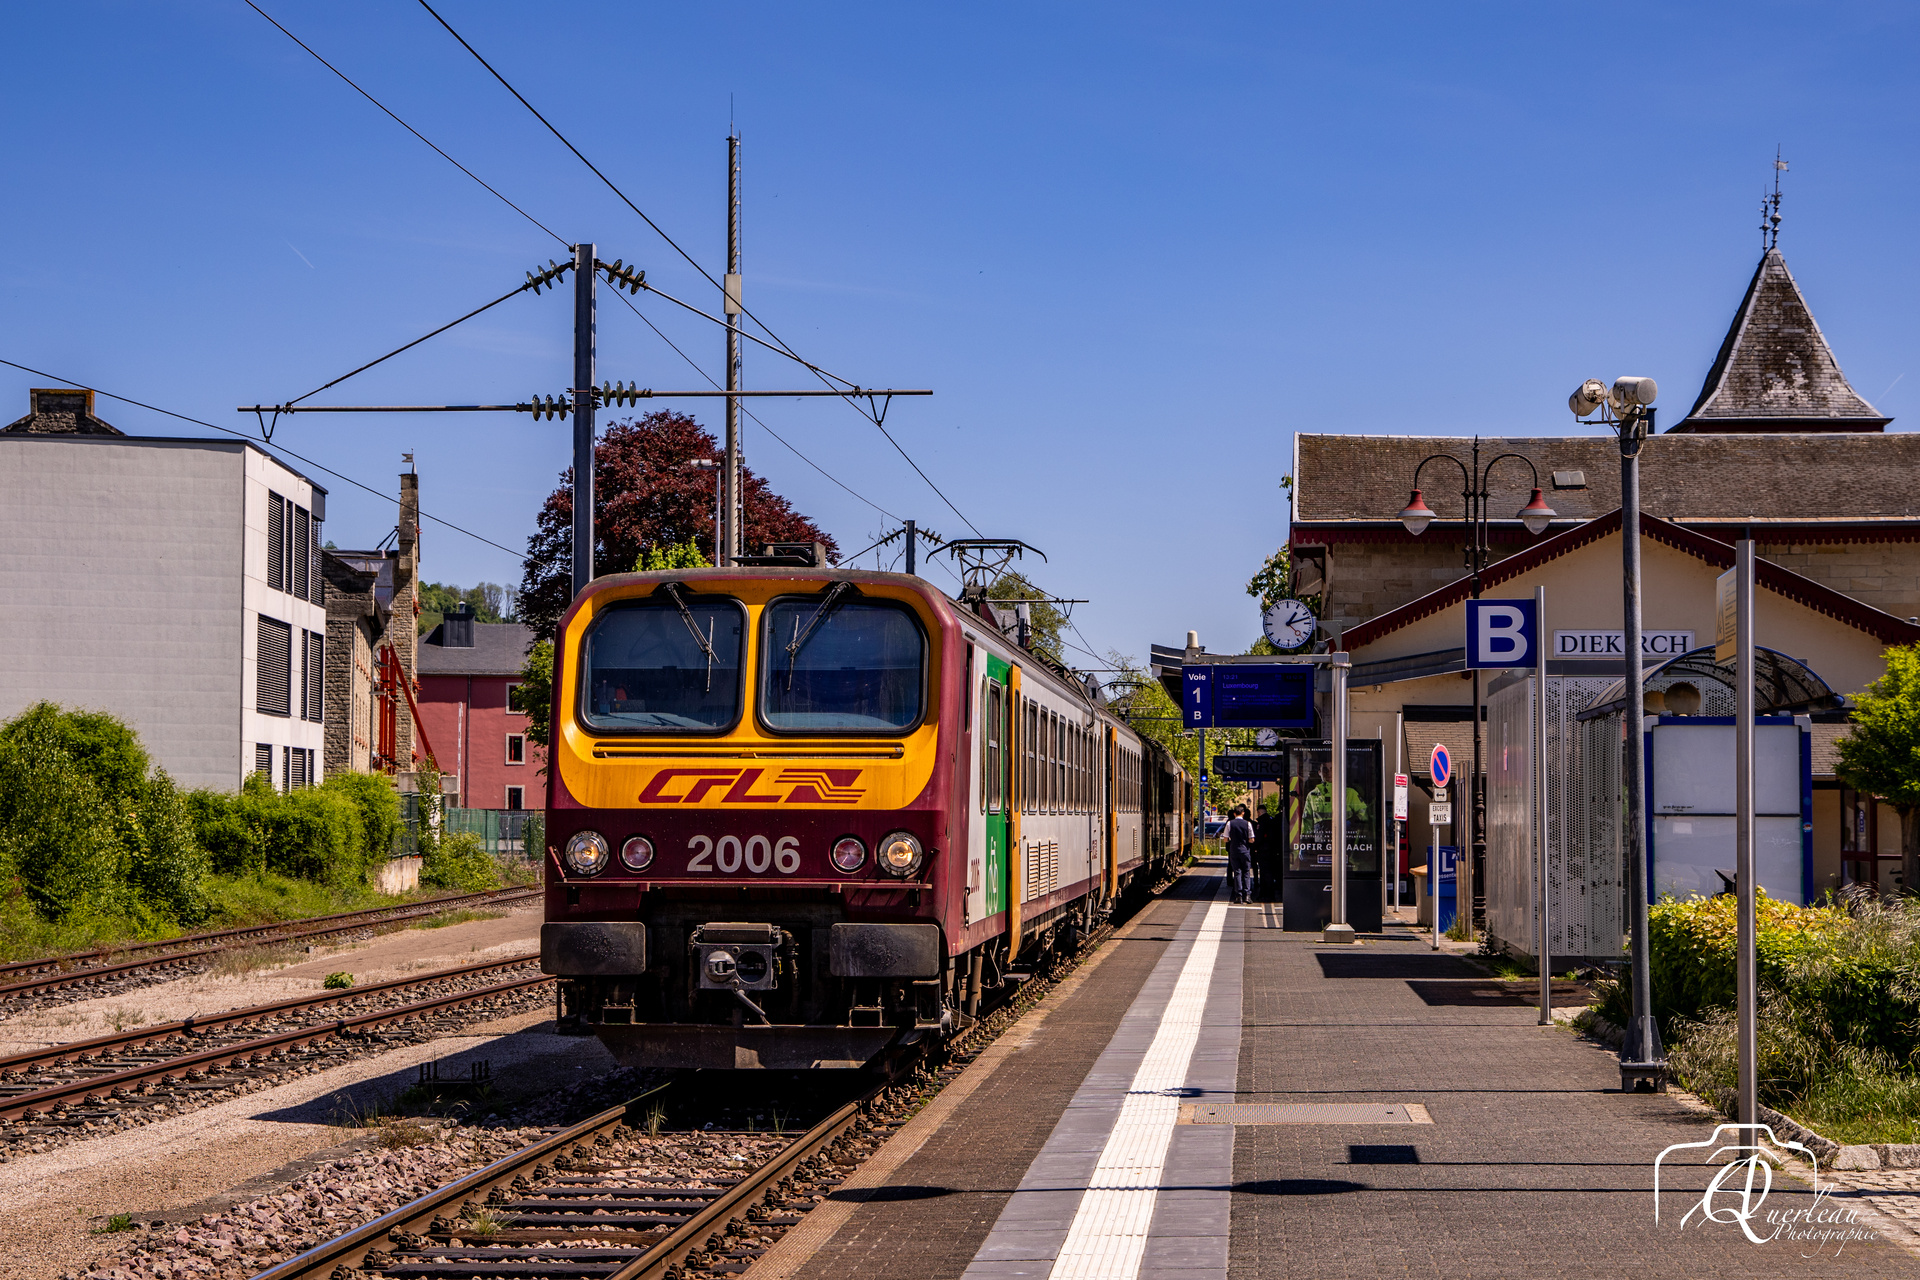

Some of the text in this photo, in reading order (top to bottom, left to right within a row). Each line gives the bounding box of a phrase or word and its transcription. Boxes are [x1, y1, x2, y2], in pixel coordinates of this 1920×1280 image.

[1478, 605, 1528, 662] B
[1560, 635, 1689, 654] DIEKRCH
[1188, 673, 1206, 681] Voie
[1222, 682, 1259, 690] Luxembourg
[1192, 687, 1201, 704] 1
[1193, 710, 1202, 720] B
[1221, 760, 1284, 773] DIEKIRC
[638, 768, 783, 803] CFL
[1433, 814, 1447, 822] TAXIS
[1293, 843, 1373, 851] DOFIR GAACH
[687, 835, 801, 874] 2006
